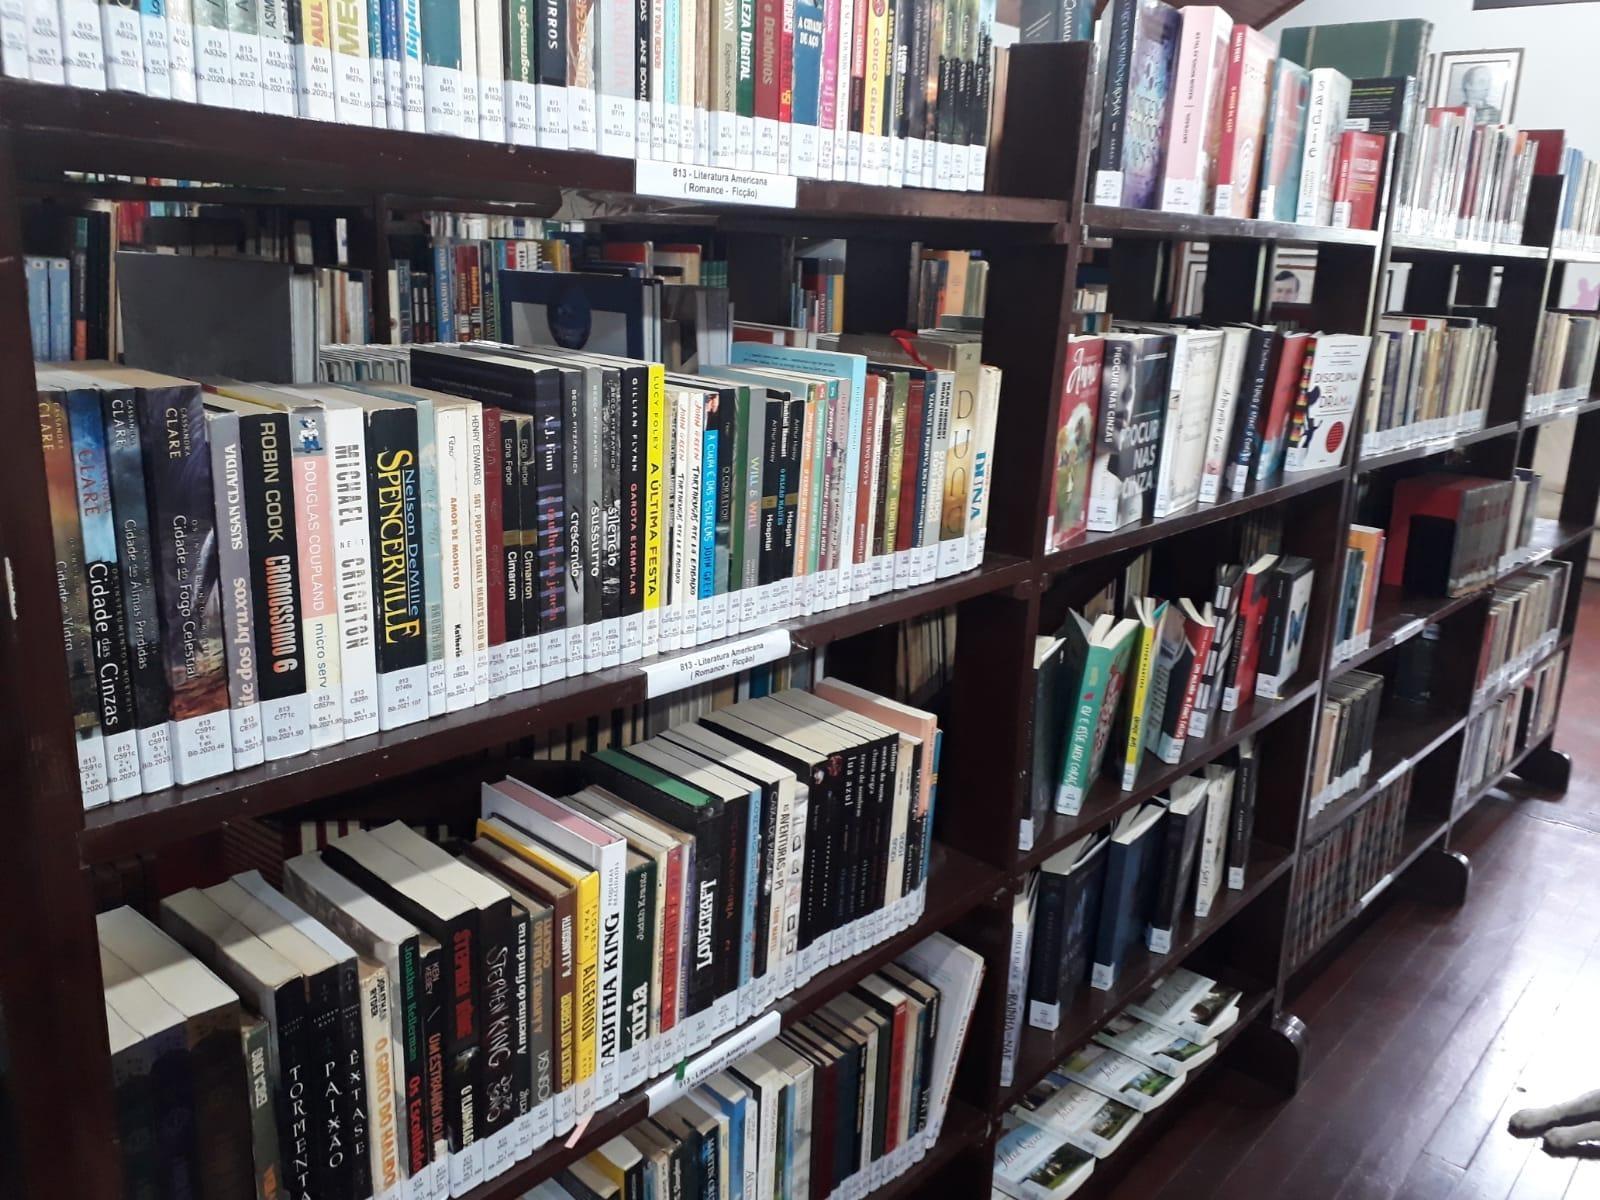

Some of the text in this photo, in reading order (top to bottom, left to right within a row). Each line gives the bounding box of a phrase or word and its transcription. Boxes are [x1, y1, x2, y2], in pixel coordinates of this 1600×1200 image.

[672, 167, 768, 187] 813 Literatura Americana
[688, 183, 724, 196] Romance
[679, 406, 687, 430] JOHN
[693, 400, 702, 427] JOHN
[1104, 346, 1123, 444] PROCURE NAS CINZAS
[110, 399, 127, 449] CLARE
[165, 407, 182, 459] CLARE
[471, 414, 482, 486] HENRY EDWARDS
[571, 421, 579, 475] FITZPATRICK
[631, 377, 639, 472] GILLIAN FLYNN
[260, 422, 283, 543] ROBIN COOK
[505, 438, 514, 486] Edna Ferber
[545, 443, 556, 471] Finn
[706, 443, 715, 470] CULPA
[1133, 444, 1158, 469] NAS
[77, 449, 101, 518] CLARE
[224, 443, 244, 551] SUSAN CLAUDIA
[334, 443, 364, 526] MICHAEL
[705, 480, 714, 496] DAS
[747, 456, 760, 530] WILL WILL
[303, 461, 325, 612] DOUGLAS COUPLAND
[376, 448, 421, 644] SPENCERVILLE
[404, 469, 426, 617] Nelson DeMille
[449, 497, 461, 590] AMOR DE MONSTRO
[569, 511, 583, 577] crescendo
[591, 506, 601, 577] sussurro
[629, 482, 638, 596] GAROTA EXEMPLAR
[648, 463, 662, 597] A ÚLTIMA FESTA
[674, 472, 685, 585] TARTARUGAS EMBAIXO
[688, 465, 701, 596] TARTARUGAS EMBAIXO
[704, 499, 713, 542] ESTRELAS
[764, 513, 774, 551] Hospital
[785, 510, 795, 547] Hospital
[507, 551, 518, 600] Cimarron
[523, 550, 534, 600] Cimarron
[703, 545, 712, 568] JOHN
[56, 560, 73, 651] Cidade Vidro
[124, 518, 147, 670] Cidade Almas Perdidas
[173, 514, 196, 679] Cidade Fogo Celestial
[265, 554, 298, 674] CROMOSSOMO 6
[341, 556, 370, 651] CRICHTON
[475, 554, 485, 641] LONELY HEARTS CLUB
[88, 562, 119, 726] Cidade das Cinzas
[233, 576, 253, 681] dos bruxos
[314, 622, 325, 659] micro
[398, 677, 409, 685] 813
[680, 642, 764, 673] 813 Literatura Americana
[694, 664, 725, 678] Romance
[198, 719, 211, 728] 813
[243, 716, 254, 725] 813
[278, 706, 290, 714] 813
[318, 695, 330, 703] 813
[1080, 704, 1093, 717] EU
[117, 743, 131, 753] 813
[151, 729, 165, 738] 813
[194, 725, 216, 735] C591c
[1074, 726, 1089, 742] ESSE
[844, 755, 857, 808] lua azul
[774, 812, 790, 891] AVENTURAS PI
[583, 908, 591, 942] PARA
[590, 904, 599, 951] FLORES
[635, 871, 648, 941] Judith Krantz
[695, 878, 718, 972] LOVECRAFT
[543, 917, 552, 969] COCKPIT
[603, 911, 620, 973] KING
[424, 965, 433, 995] KESEY
[432, 961, 440, 982] KEN
[486, 946, 510, 1015] STEPHEN
[515, 922, 527, 1055] A menina do fim da rua
[531, 920, 544, 1033] A ÁRVORE DO DIABO
[369, 987, 379, 1018] RYDER
[376, 977, 388, 1022] JONATHAN
[403, 945, 419, 1062] Jonathan Kellerman
[560, 991, 573, 1047] DO TERROR
[581, 963, 596, 1042] ALGERNON
[1003, 993, 1018, 1033] RAINHA
[487, 1015, 512, 1067] KING
[374, 1036, 393, 1128] O GRITO DO
[408, 1076, 422, 1096] Os
[429, 1032, 443, 1133] UM ESTRANHO NO
[460, 1084, 473, 1095] O
[325, 1061, 344, 1168] PAIXÃO
